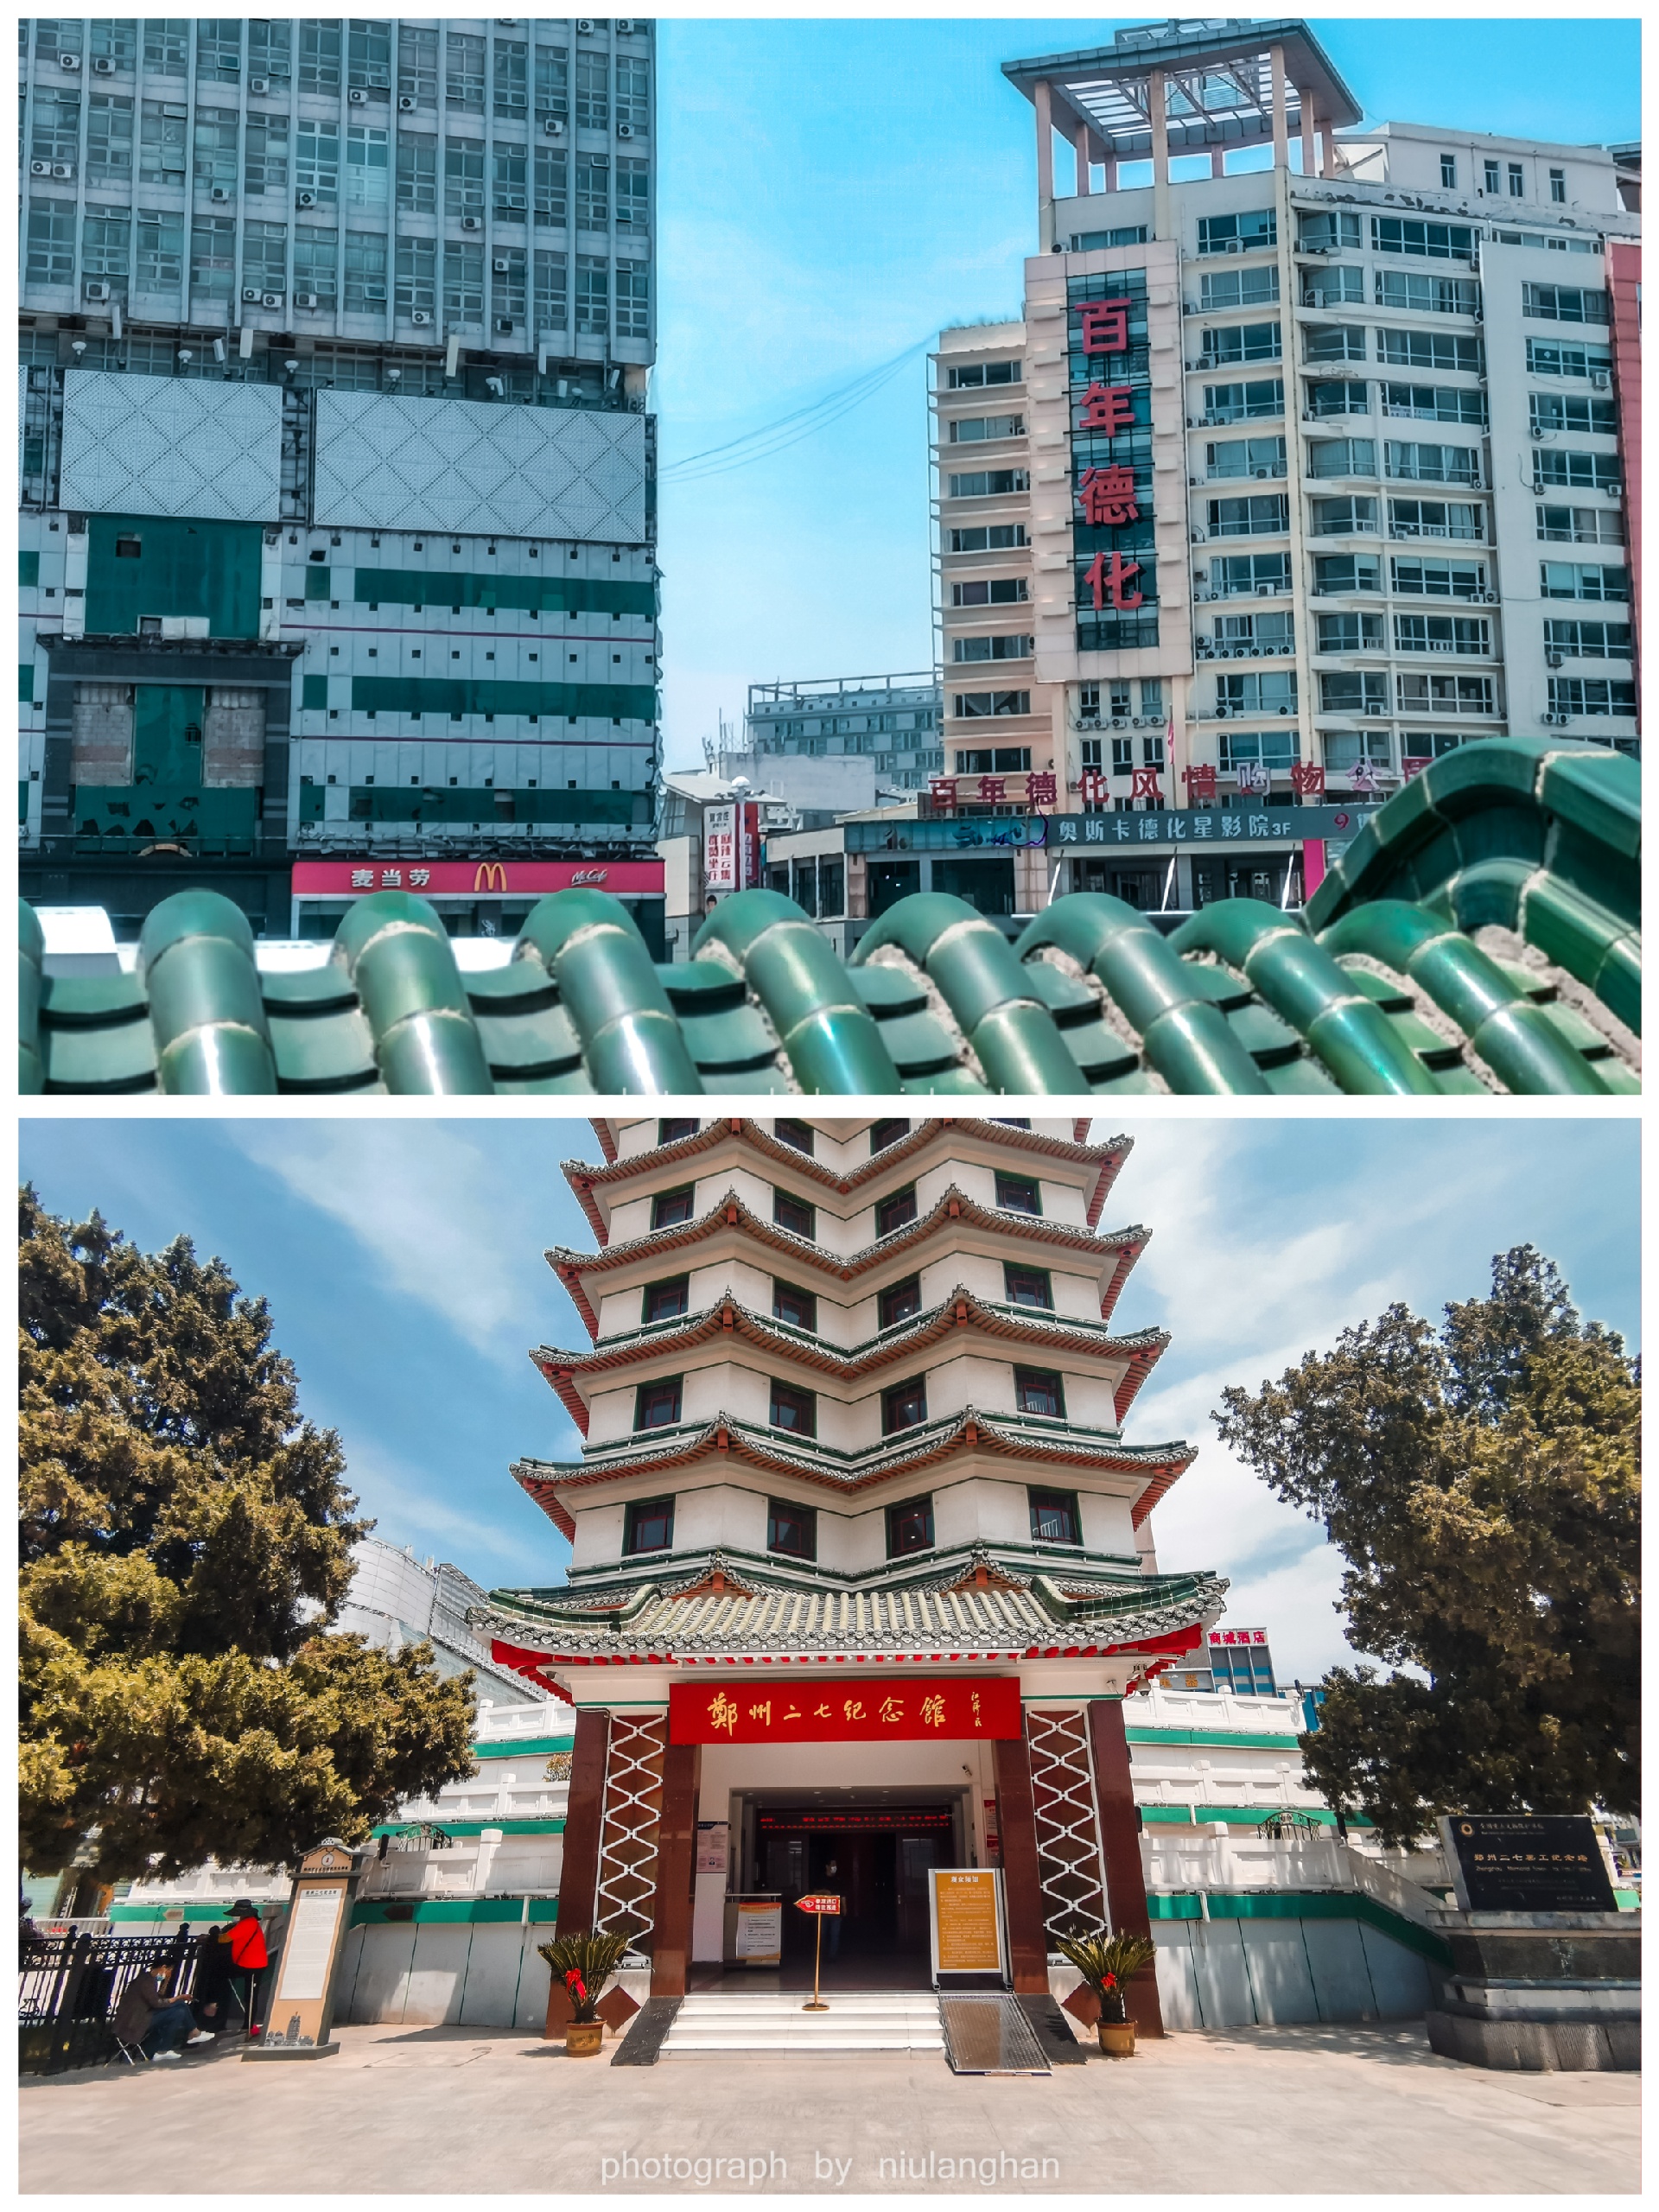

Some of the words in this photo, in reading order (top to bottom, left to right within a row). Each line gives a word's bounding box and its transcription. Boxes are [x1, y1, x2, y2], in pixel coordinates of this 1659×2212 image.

[1075, 297, 1142, 611] 百年德化
[351, 868, 430, 888] 麦当劳
[1209, 1630, 1265, 1644] 商城酒店
